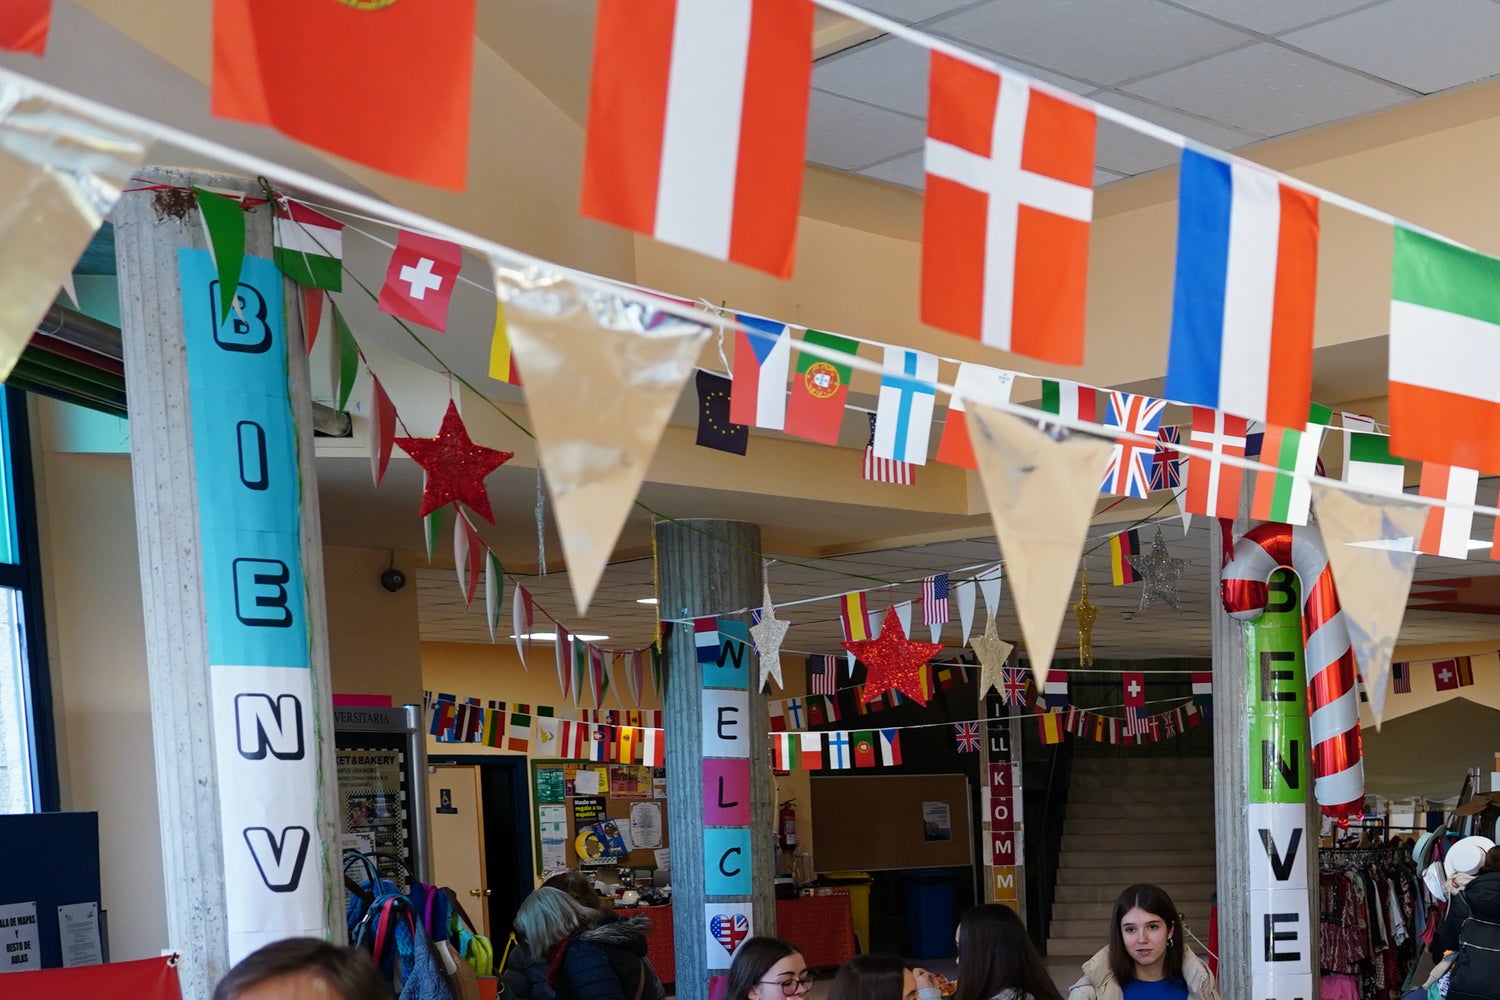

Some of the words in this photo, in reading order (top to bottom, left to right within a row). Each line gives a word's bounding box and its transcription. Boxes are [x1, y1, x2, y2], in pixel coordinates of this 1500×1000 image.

[209, 279, 310, 894] BIENV
[10, 917, 17, 927] DE
[18, 915, 36, 926] MAPAS
[6, 942, 23, 953] RESTO
[24, 941, 31, 950] DE
[11, 954, 29, 965] AULAS
